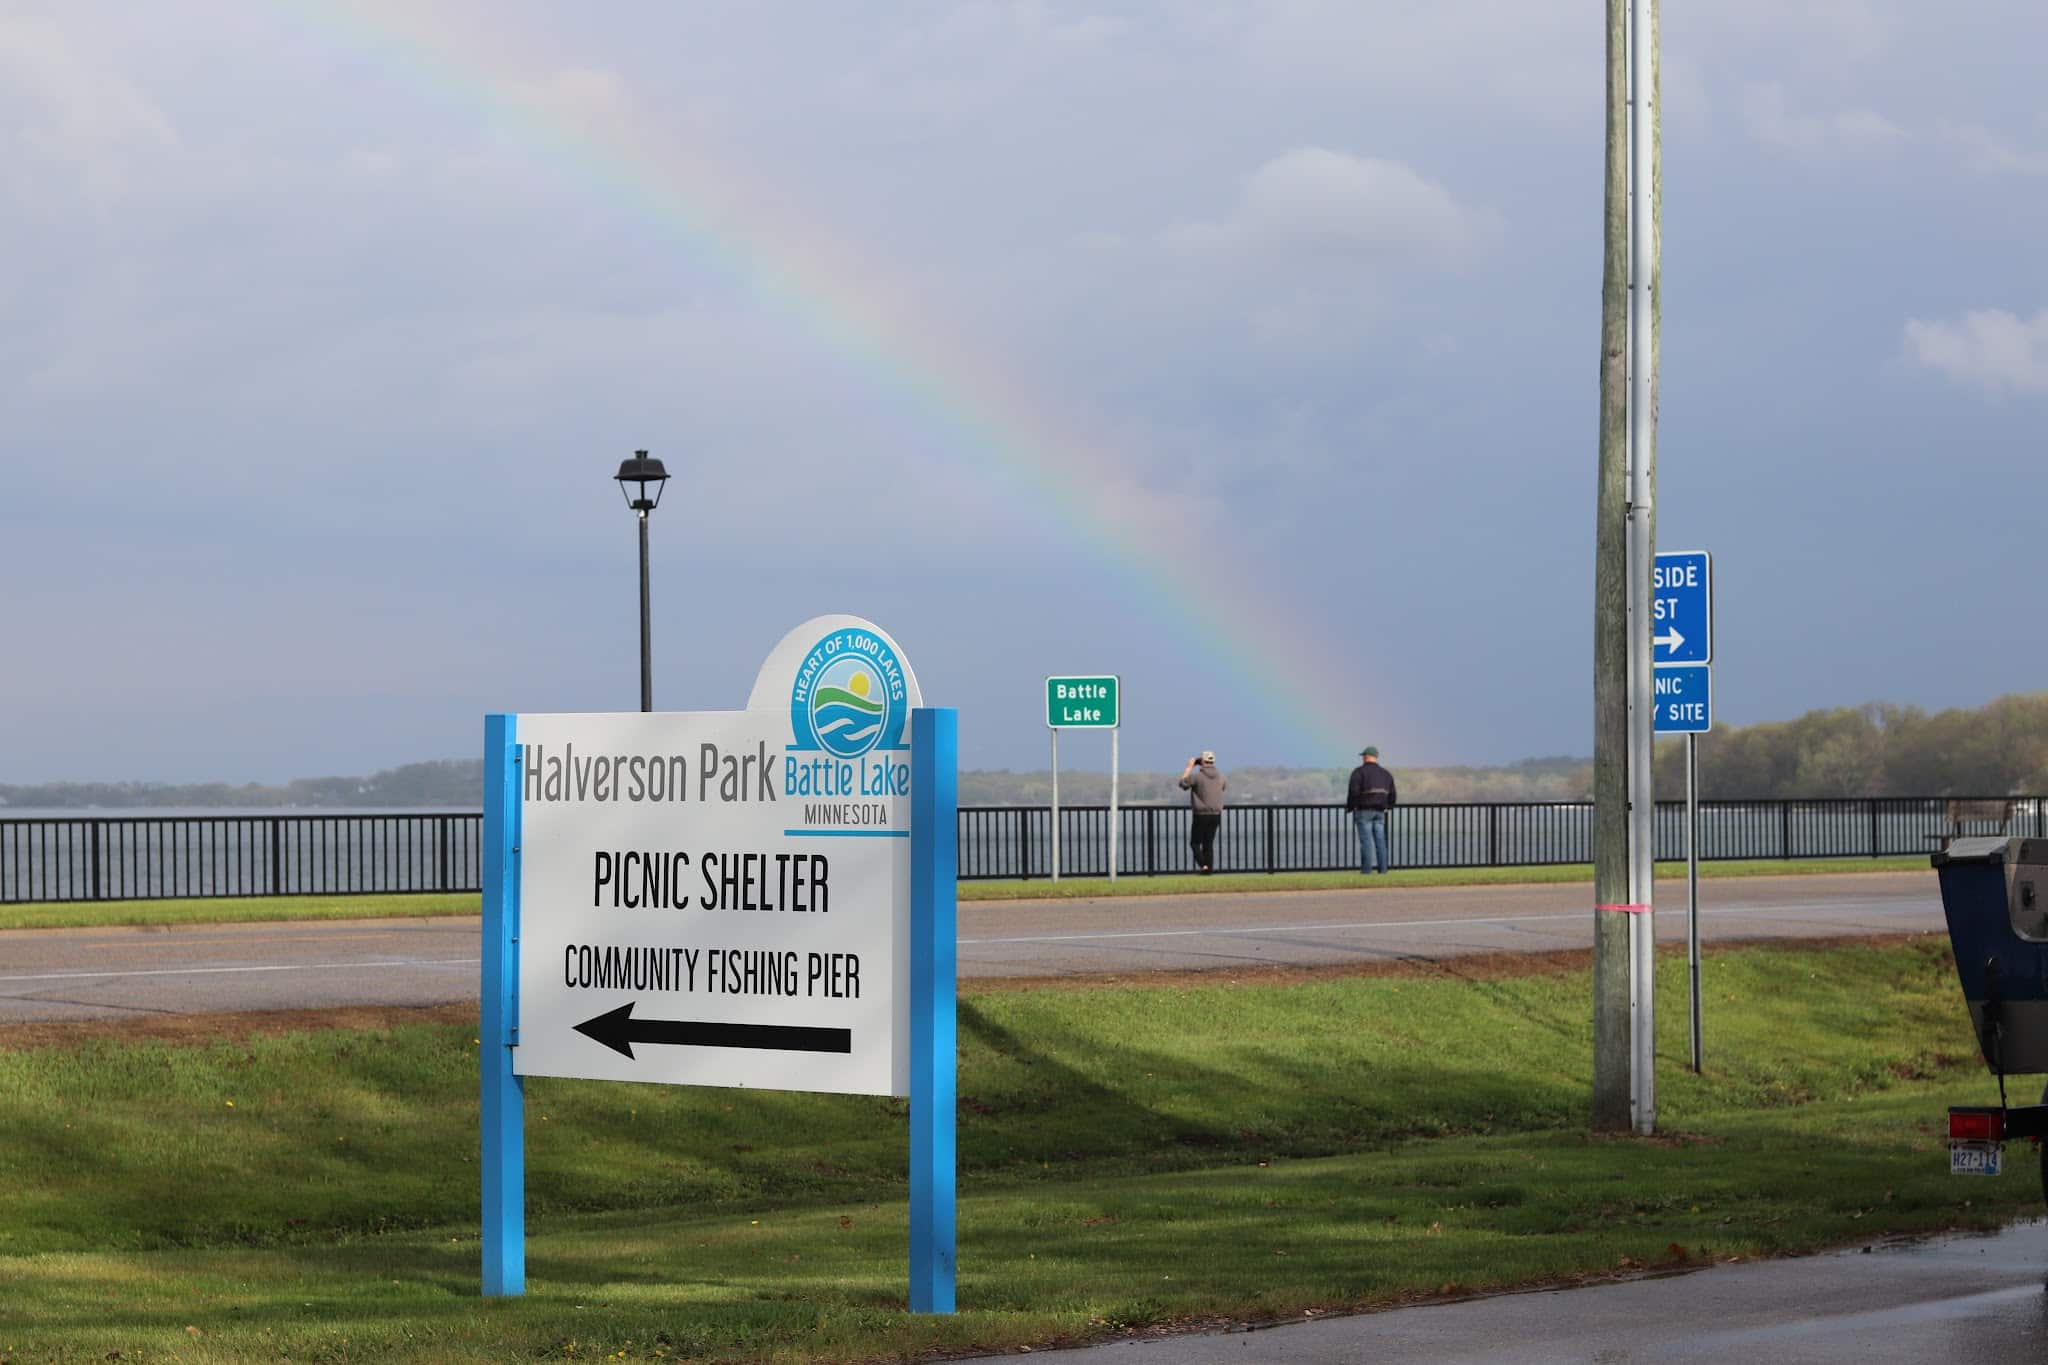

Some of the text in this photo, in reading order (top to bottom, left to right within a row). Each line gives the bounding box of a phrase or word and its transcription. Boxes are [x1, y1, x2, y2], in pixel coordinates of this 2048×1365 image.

[1653, 566, 1698, 588] SIDE
[1653, 598, 1678, 620] ST
[794, 648, 825, 702] HEART
[825, 636, 843, 655] OF
[876, 649, 904, 701] LAKES
[1057, 684, 1107, 699] Battle
[1655, 677, 1682, 695] NIC
[1063, 706, 1101, 721] Lake
[1669, 703, 1705, 721] SITE
[524, 740, 777, 802] Halverson Park
[785, 754, 910, 797] Battle Lake
[804, 804, 888, 825] MINNESOTA
[594, 851, 830, 913] PICNIC SHELTER
[564, 944, 861, 999] COMMUNITY FISHING PIER
